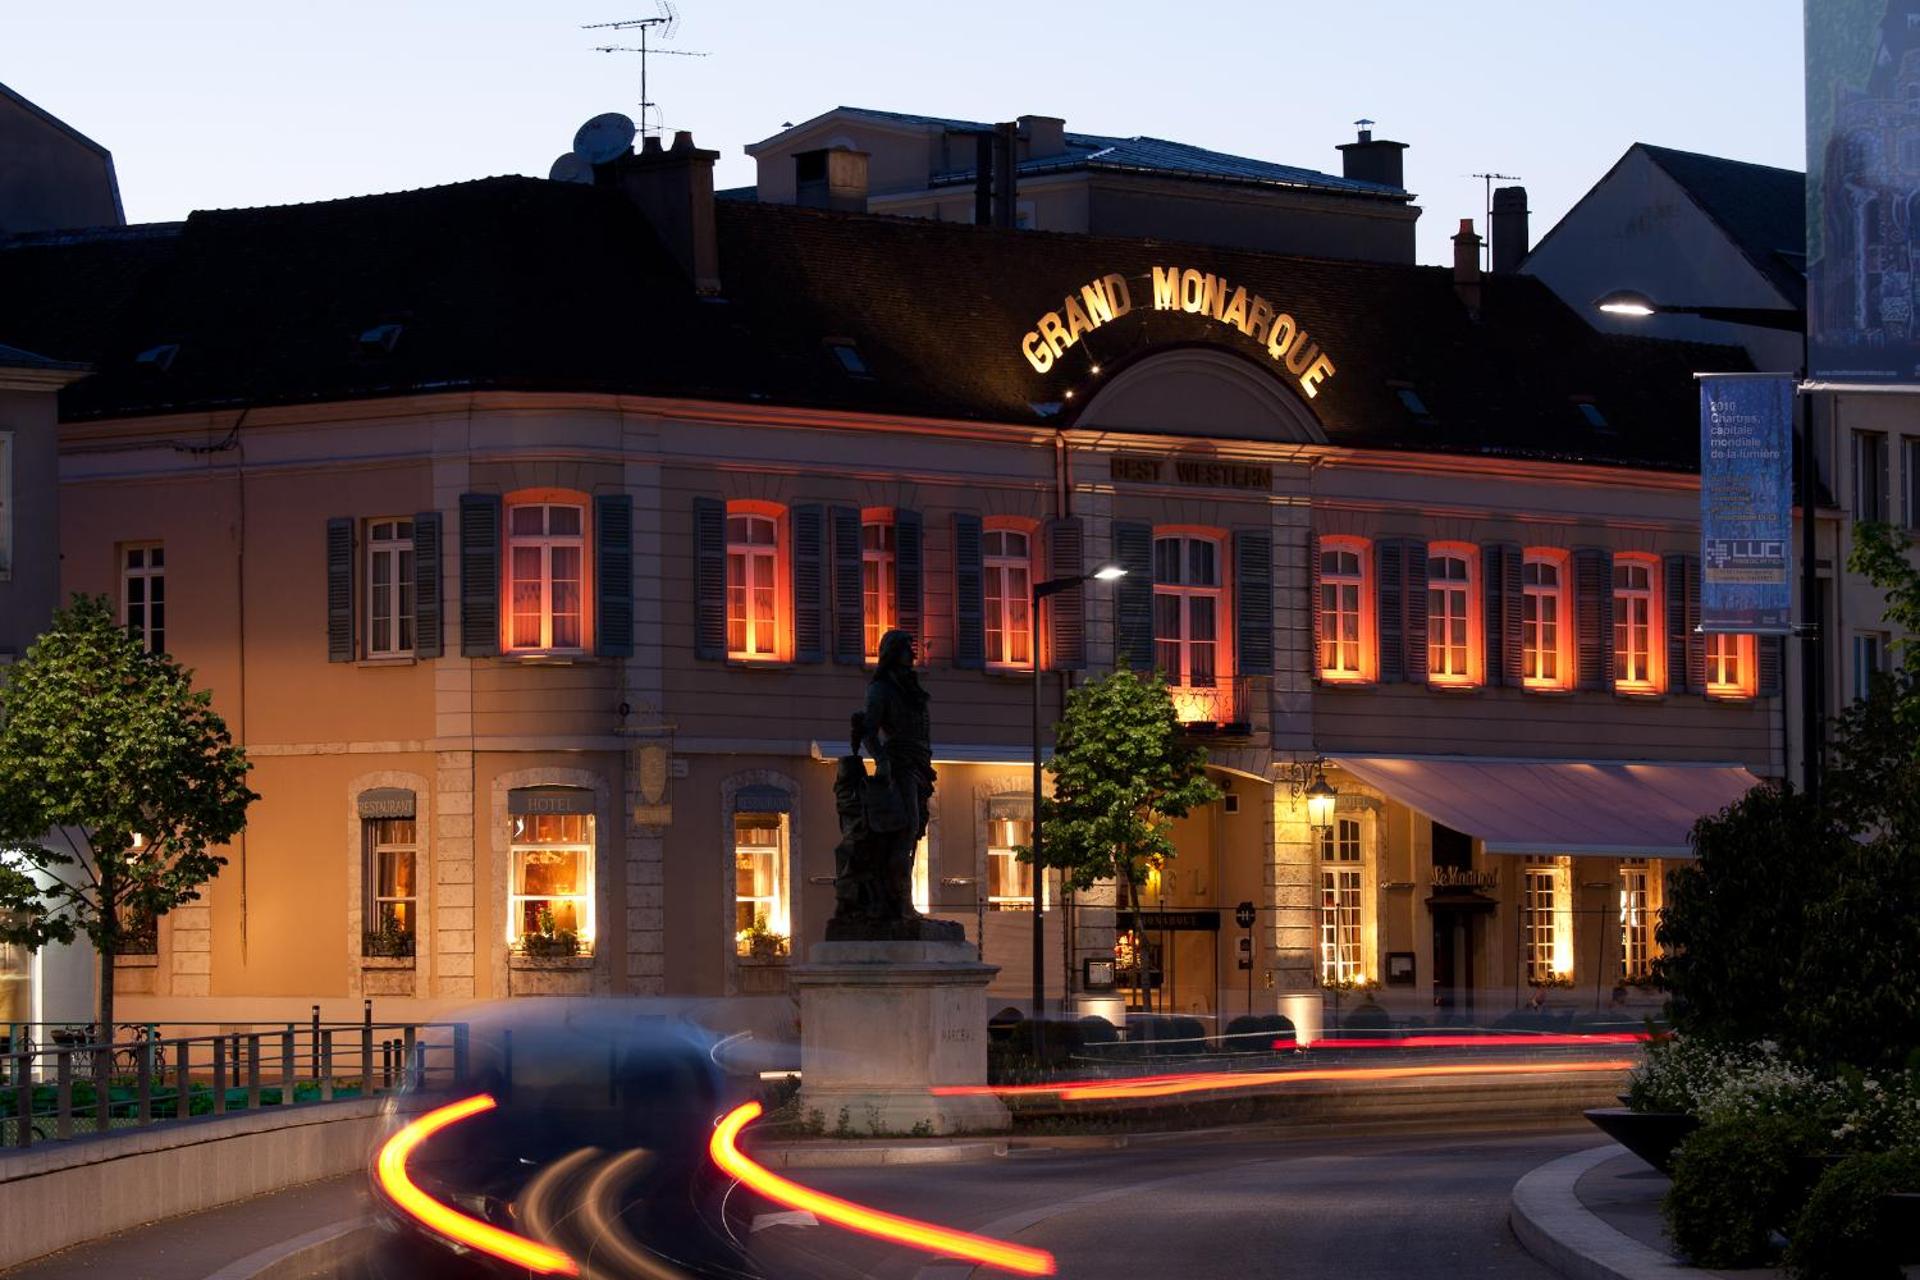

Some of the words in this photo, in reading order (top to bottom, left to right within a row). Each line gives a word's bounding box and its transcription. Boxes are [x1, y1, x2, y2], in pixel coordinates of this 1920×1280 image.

[1022, 272, 1132, 375] GRAND
[1152, 266, 1337, 399] MONARQUE
[1710, 426, 1753, 437] capitale
[1710, 438, 1761, 448] mondiale
[1710, 449, 1725, 459] de
[1727, 449, 1737, 459] la
[1110, 457, 1162, 482] BEST
[1175, 461, 1273, 489] WESTERN
[1732, 542, 1785, 558] LUCI
[359, 799, 413, 814] RESTAURANT
[527, 797, 573, 811] HOTEL
